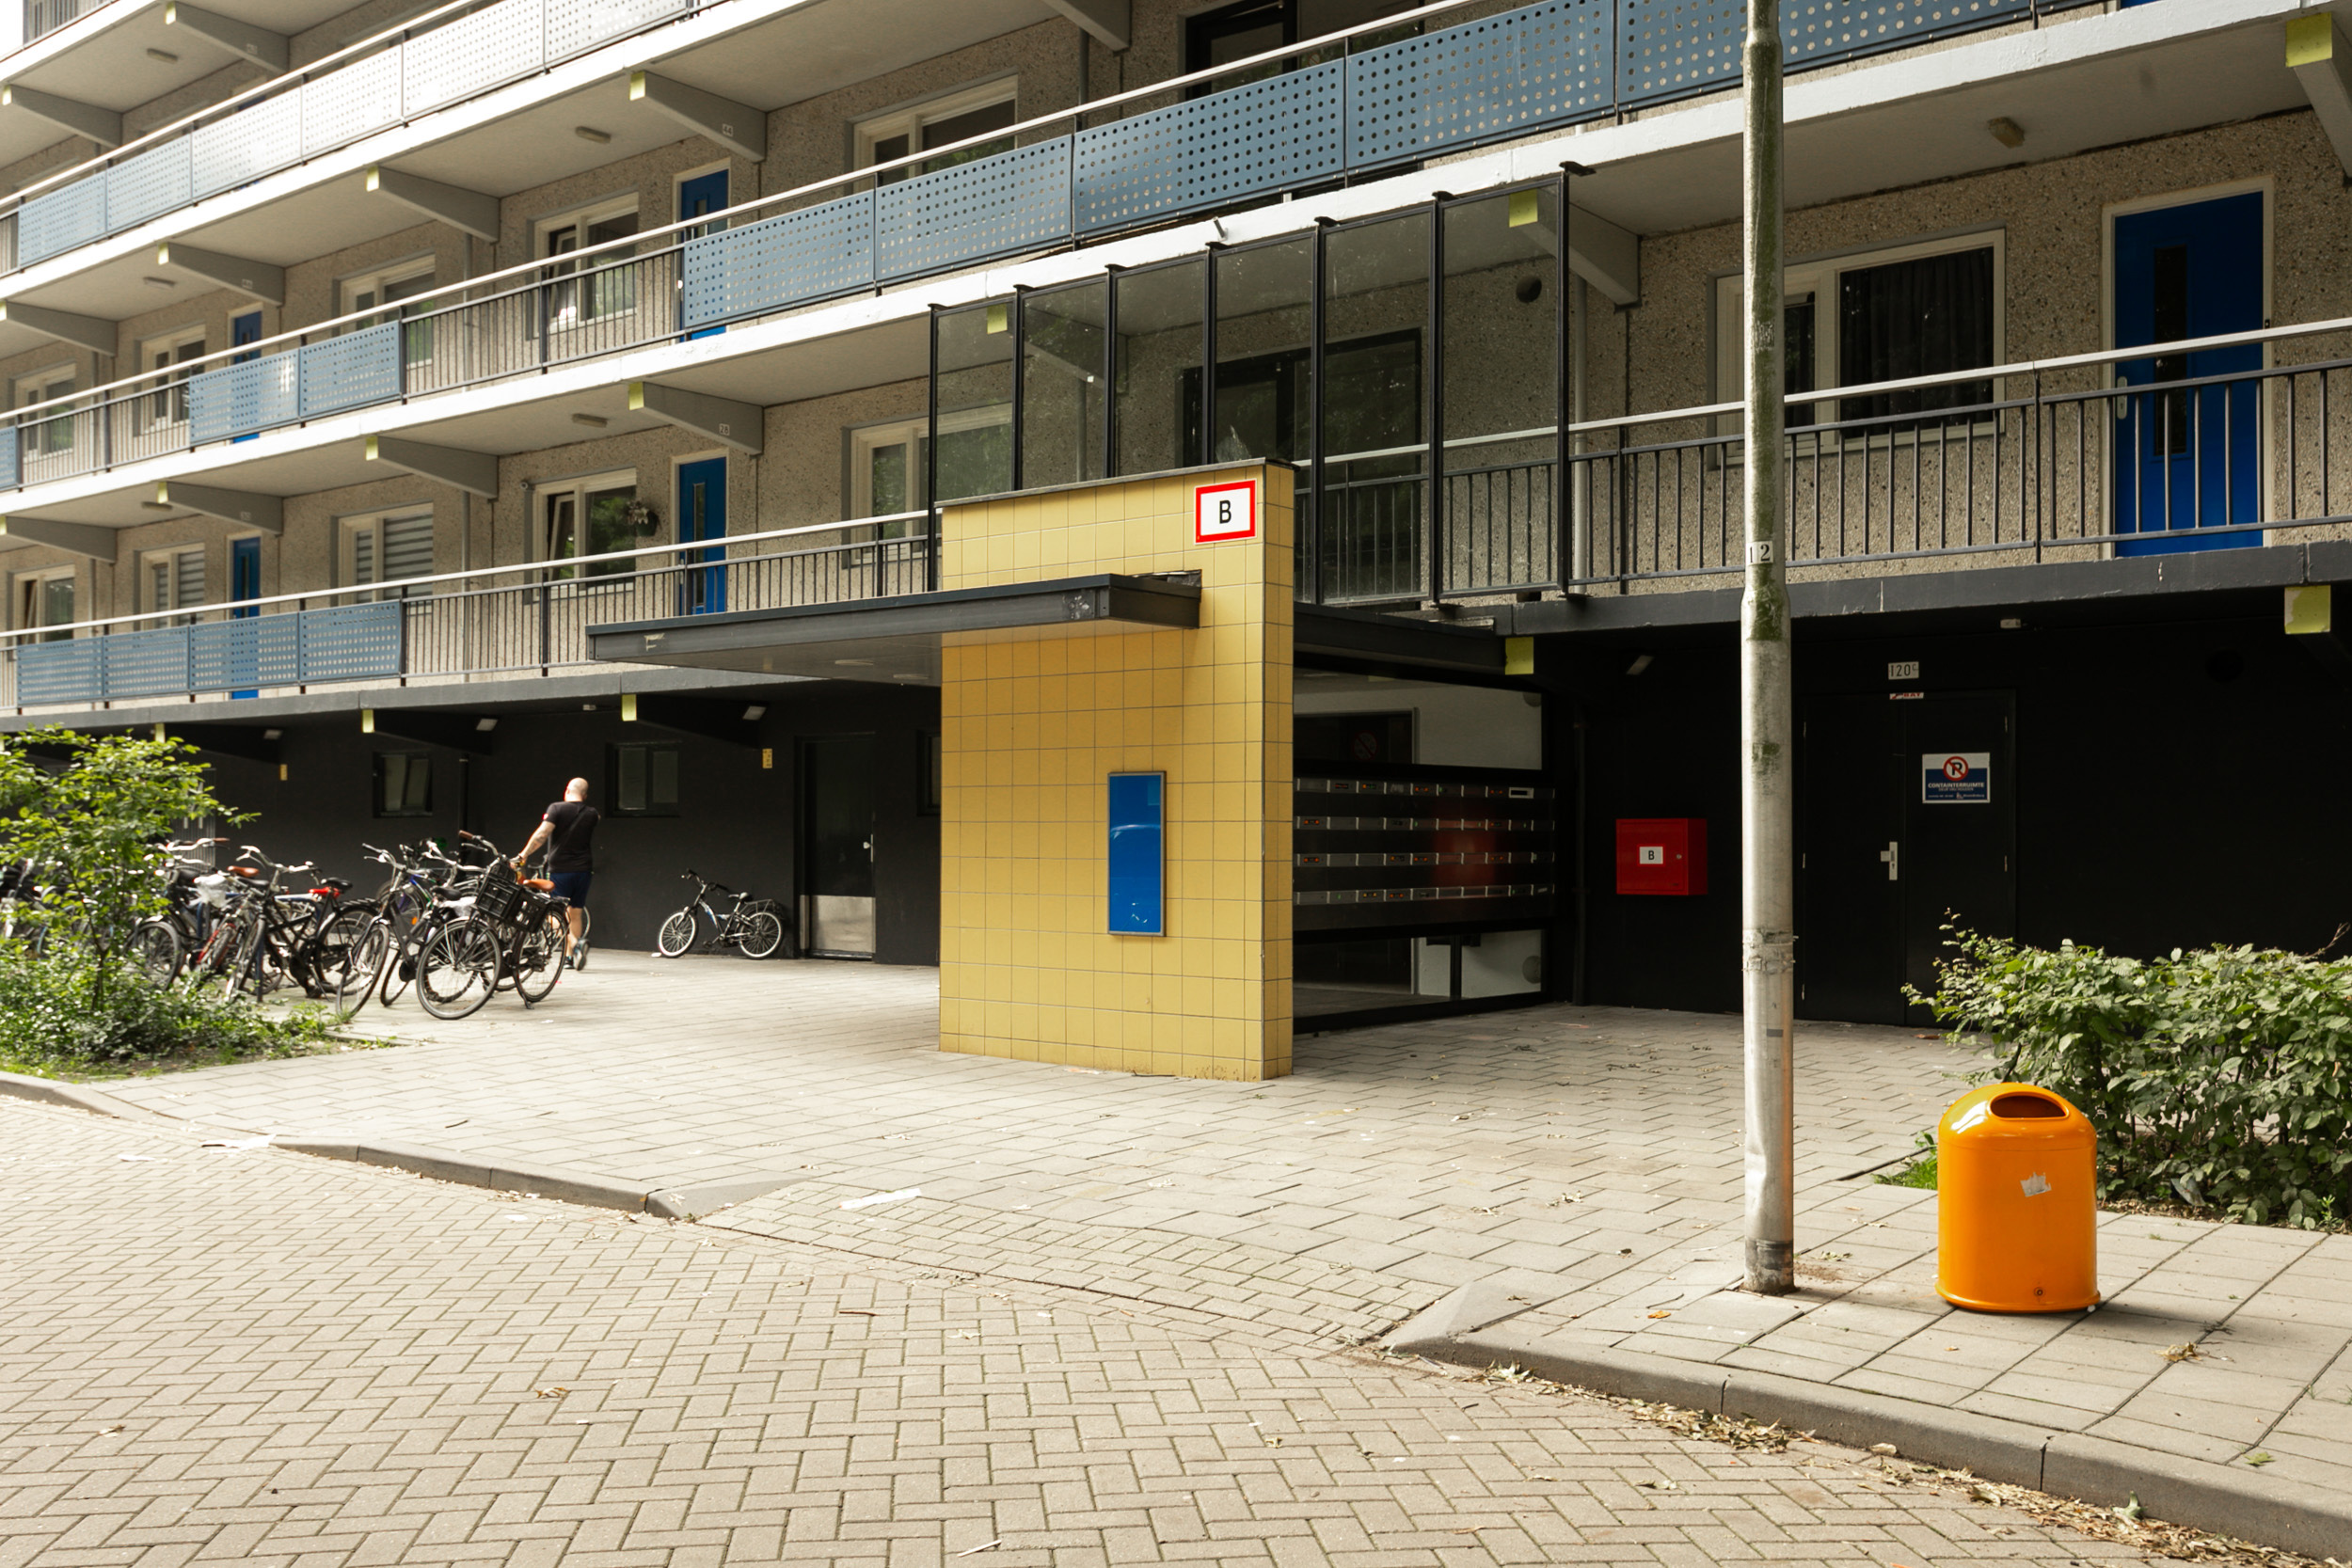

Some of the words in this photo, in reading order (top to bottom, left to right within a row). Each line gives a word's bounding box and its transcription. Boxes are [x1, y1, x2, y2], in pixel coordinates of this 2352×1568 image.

[1219, 499, 1232, 524] B
[1749, 544, 1771, 563] 12
[1648, 850, 1655, 861] B
